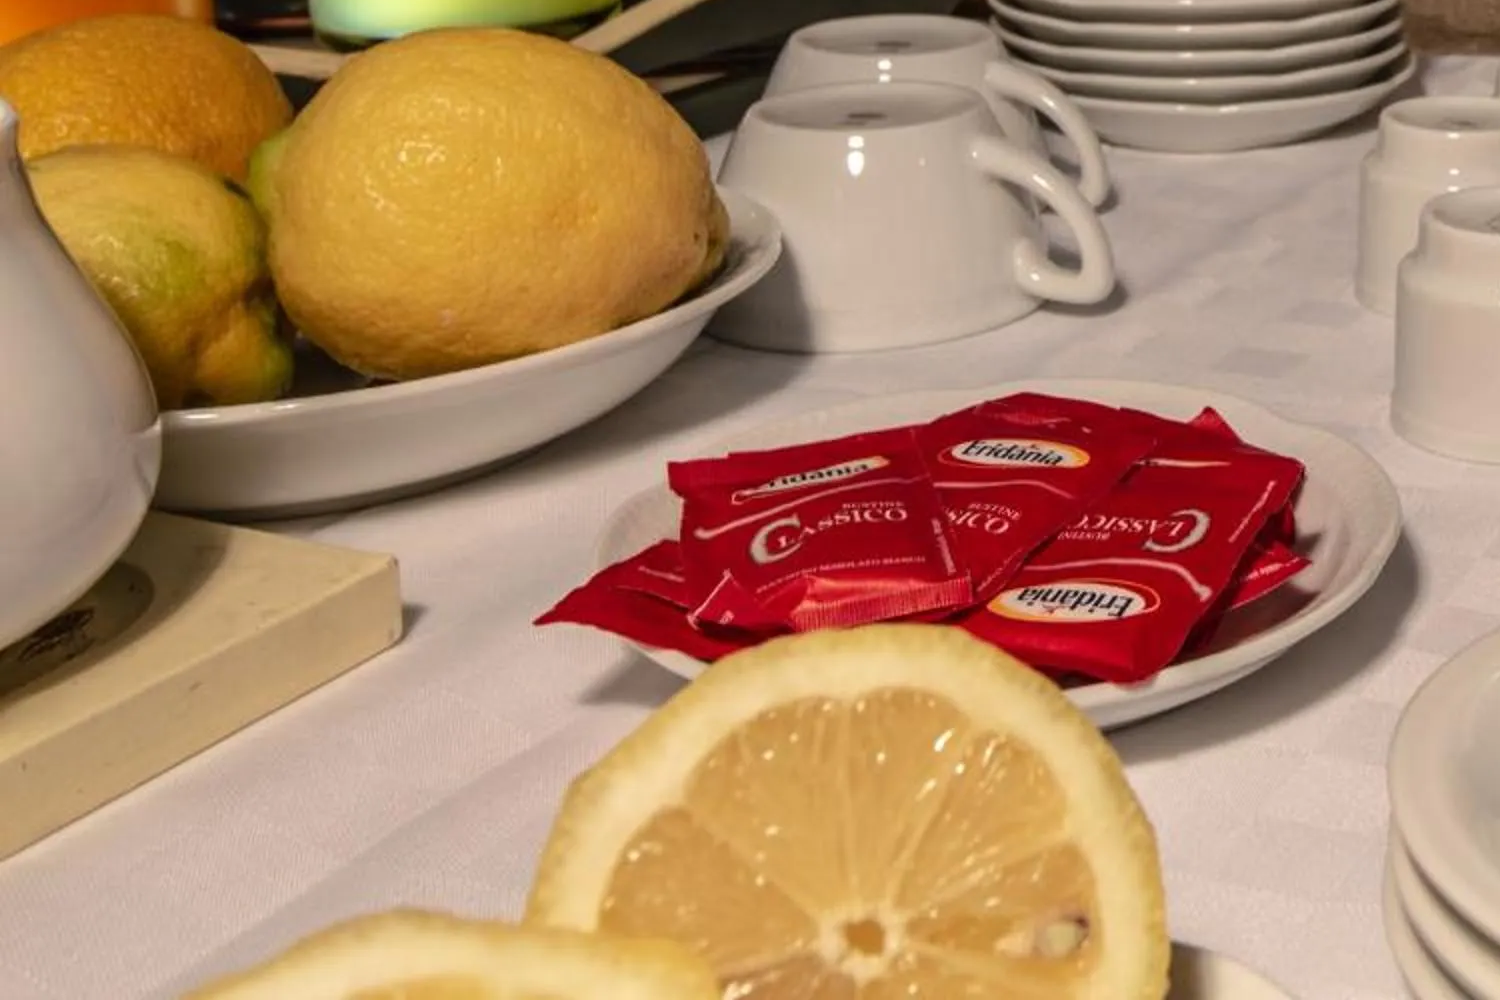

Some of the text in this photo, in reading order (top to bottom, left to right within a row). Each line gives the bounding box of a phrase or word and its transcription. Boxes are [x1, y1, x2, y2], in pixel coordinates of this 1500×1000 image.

[961, 439, 1064, 466] Eridania
[750, 509, 908, 567] CLASSICO
[1018, 588, 1135, 620] Eridania
